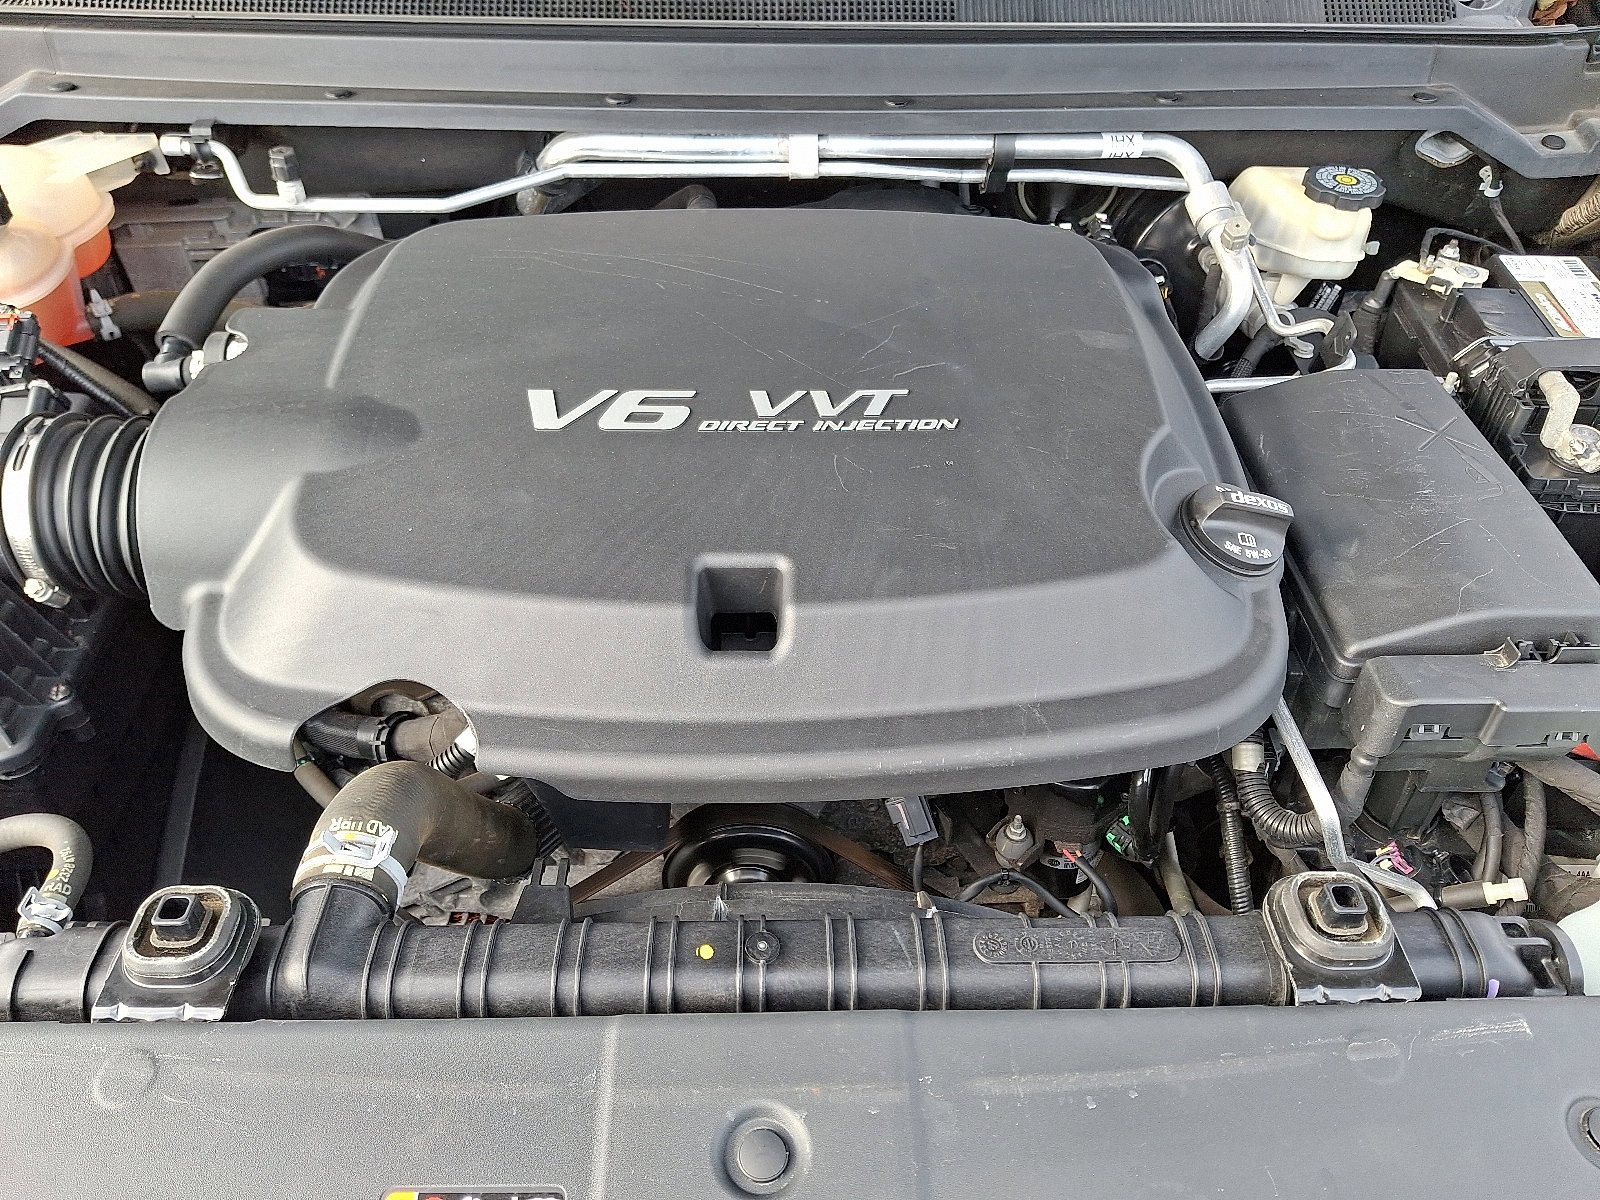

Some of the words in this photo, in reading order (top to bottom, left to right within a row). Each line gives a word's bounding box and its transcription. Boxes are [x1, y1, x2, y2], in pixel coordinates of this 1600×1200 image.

[527, 389, 697, 432] V6
[749, 389, 910, 418] VVT
[698, 419, 805, 433] DIRECT
[811, 418, 960, 433] INJECTION
[1230, 491, 1289, 514] dexos
[43, 882, 72, 895] RAD
